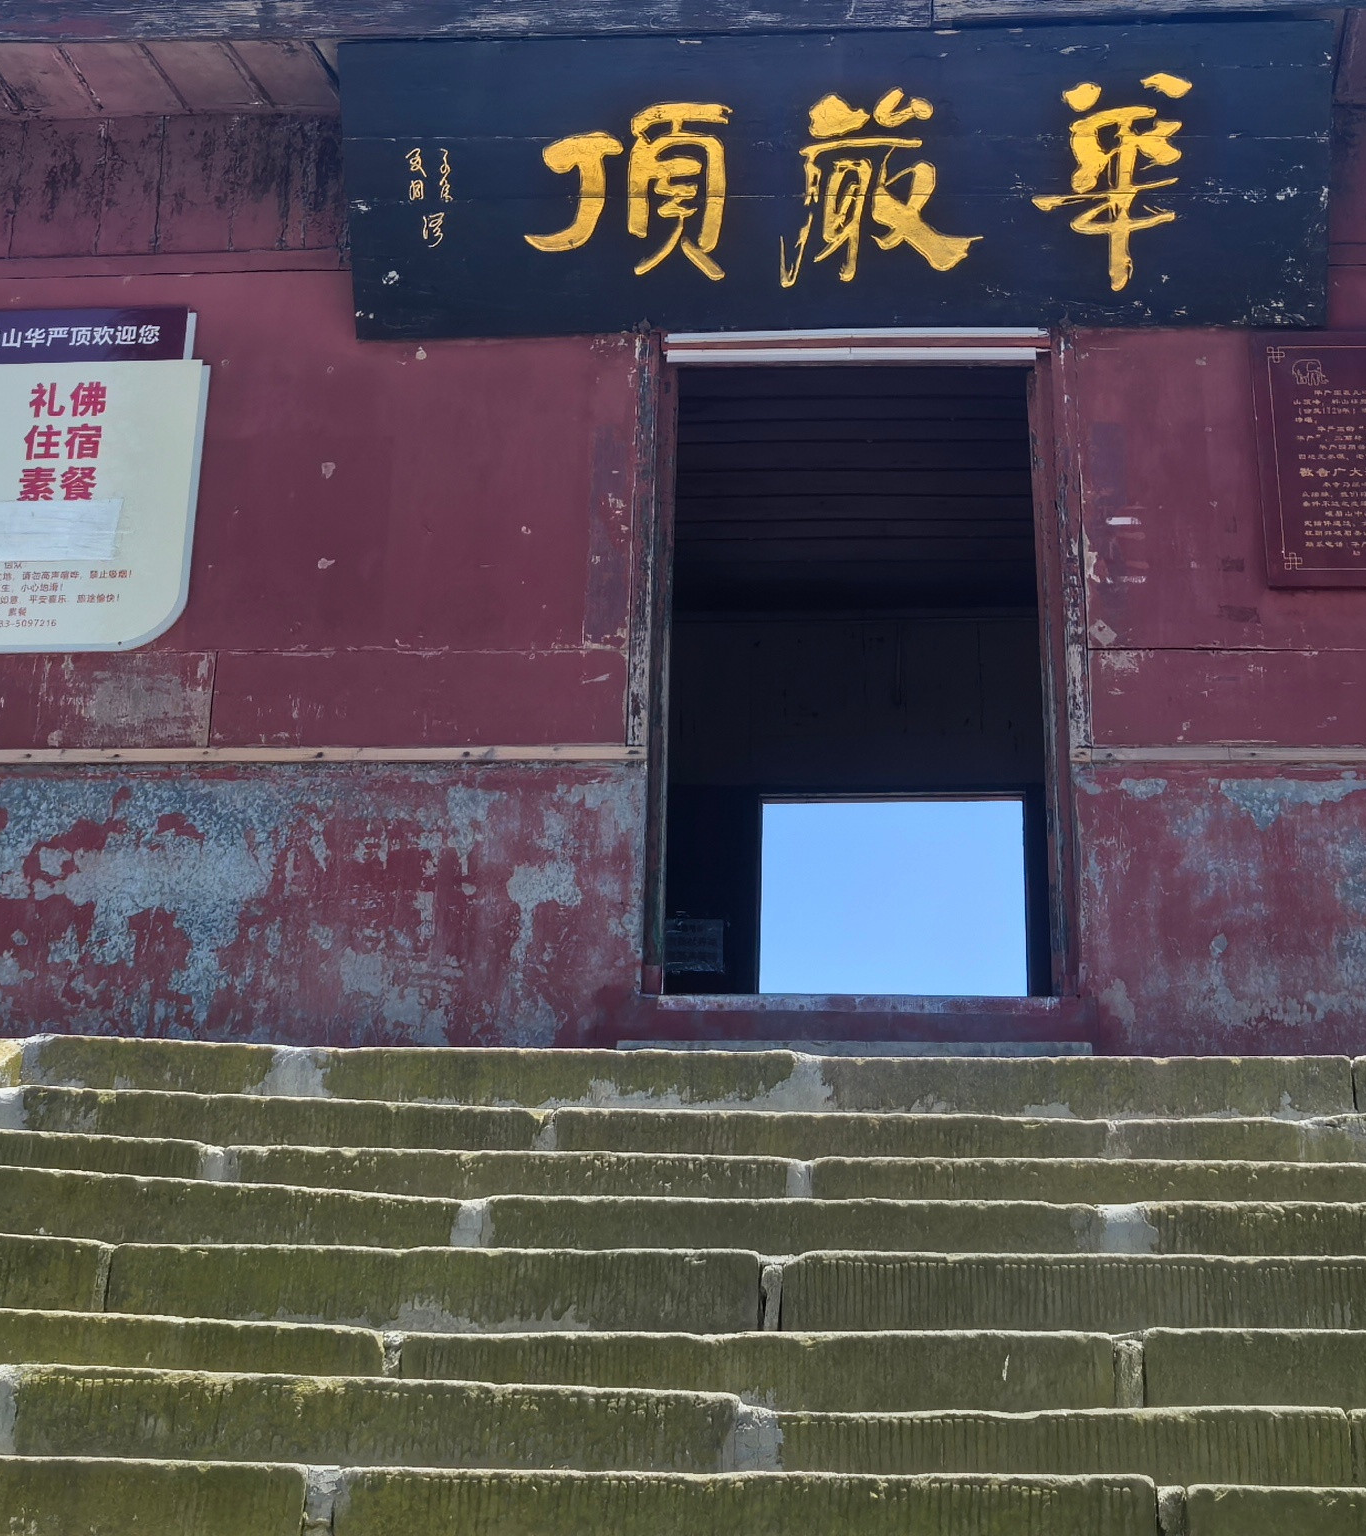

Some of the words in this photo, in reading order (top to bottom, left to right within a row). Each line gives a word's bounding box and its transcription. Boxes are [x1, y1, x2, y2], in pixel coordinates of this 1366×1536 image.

[28, 381, 107, 418] 礼佛
[23, 423, 102, 461] 住宿
[16, 466, 97, 502] 素餐
